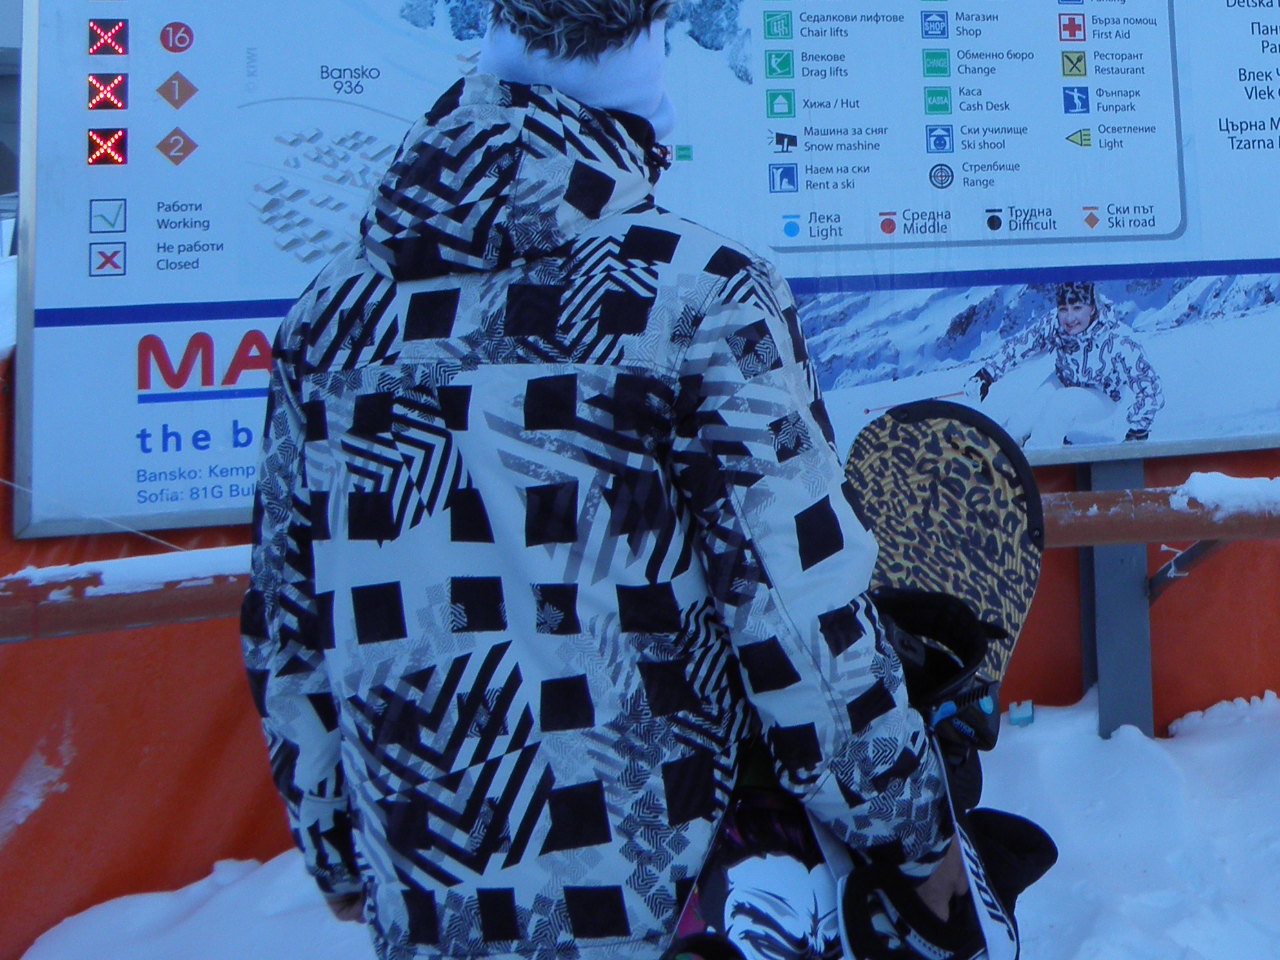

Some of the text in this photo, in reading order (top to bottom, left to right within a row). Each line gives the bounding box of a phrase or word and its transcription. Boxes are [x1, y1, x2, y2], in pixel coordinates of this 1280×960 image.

[956, 12, 998, 21] Магазин
[925, 22, 945, 31] SHOP
[956, 26, 982, 38] Shop
[166, 27, 189, 48] 16
[801, 52, 845, 61] Влекове
[1094, 51, 1143, 62] Ресторант
[320, 65, 380, 79] Bansko
[802, 67, 848, 79] Drag lifts
[1095, 66, 1145, 74] Restaurant
[172, 80, 179, 100] 1
[333, 80, 364, 94] 936
[959, 87, 982, 96] Каса
[1096, 88, 1140, 98] Фънпарк
[803, 99, 860, 108] Хижа Hut
[1098, 124, 1156, 134] Осветление
[1218, 118, 1266, 134] Църна
[169, 136, 184, 156] 2
[804, 141, 880, 151] Snow mashine
[961, 140, 1005, 150] Ski shool
[1228, 136, 1274, 150] Tzarna
[962, 162, 1020, 173] Стрелбище
[963, 178, 994, 188] Range
[157, 201, 202, 212] Работи
[1107, 204, 1154, 215] Ски път
[808, 212, 840, 224] Лека
[902, 209, 951, 222] Средна
[1008, 206, 1052, 221] Трудна
[157, 218, 210, 231] Working
[903, 222, 947, 234] Middle
[1009, 219, 1056, 231] Difficult
[1108, 216, 1155, 228] Ski road
[809, 226, 843, 240] Light
[157, 242, 224, 254] Не работи
[157, 258, 199, 270] Closed
[136, 424, 211, 454] the
[137, 467, 202, 483] Bansko:
[137, 489, 184, 504] Sofia:
[190, 486, 223, 500] 81G
